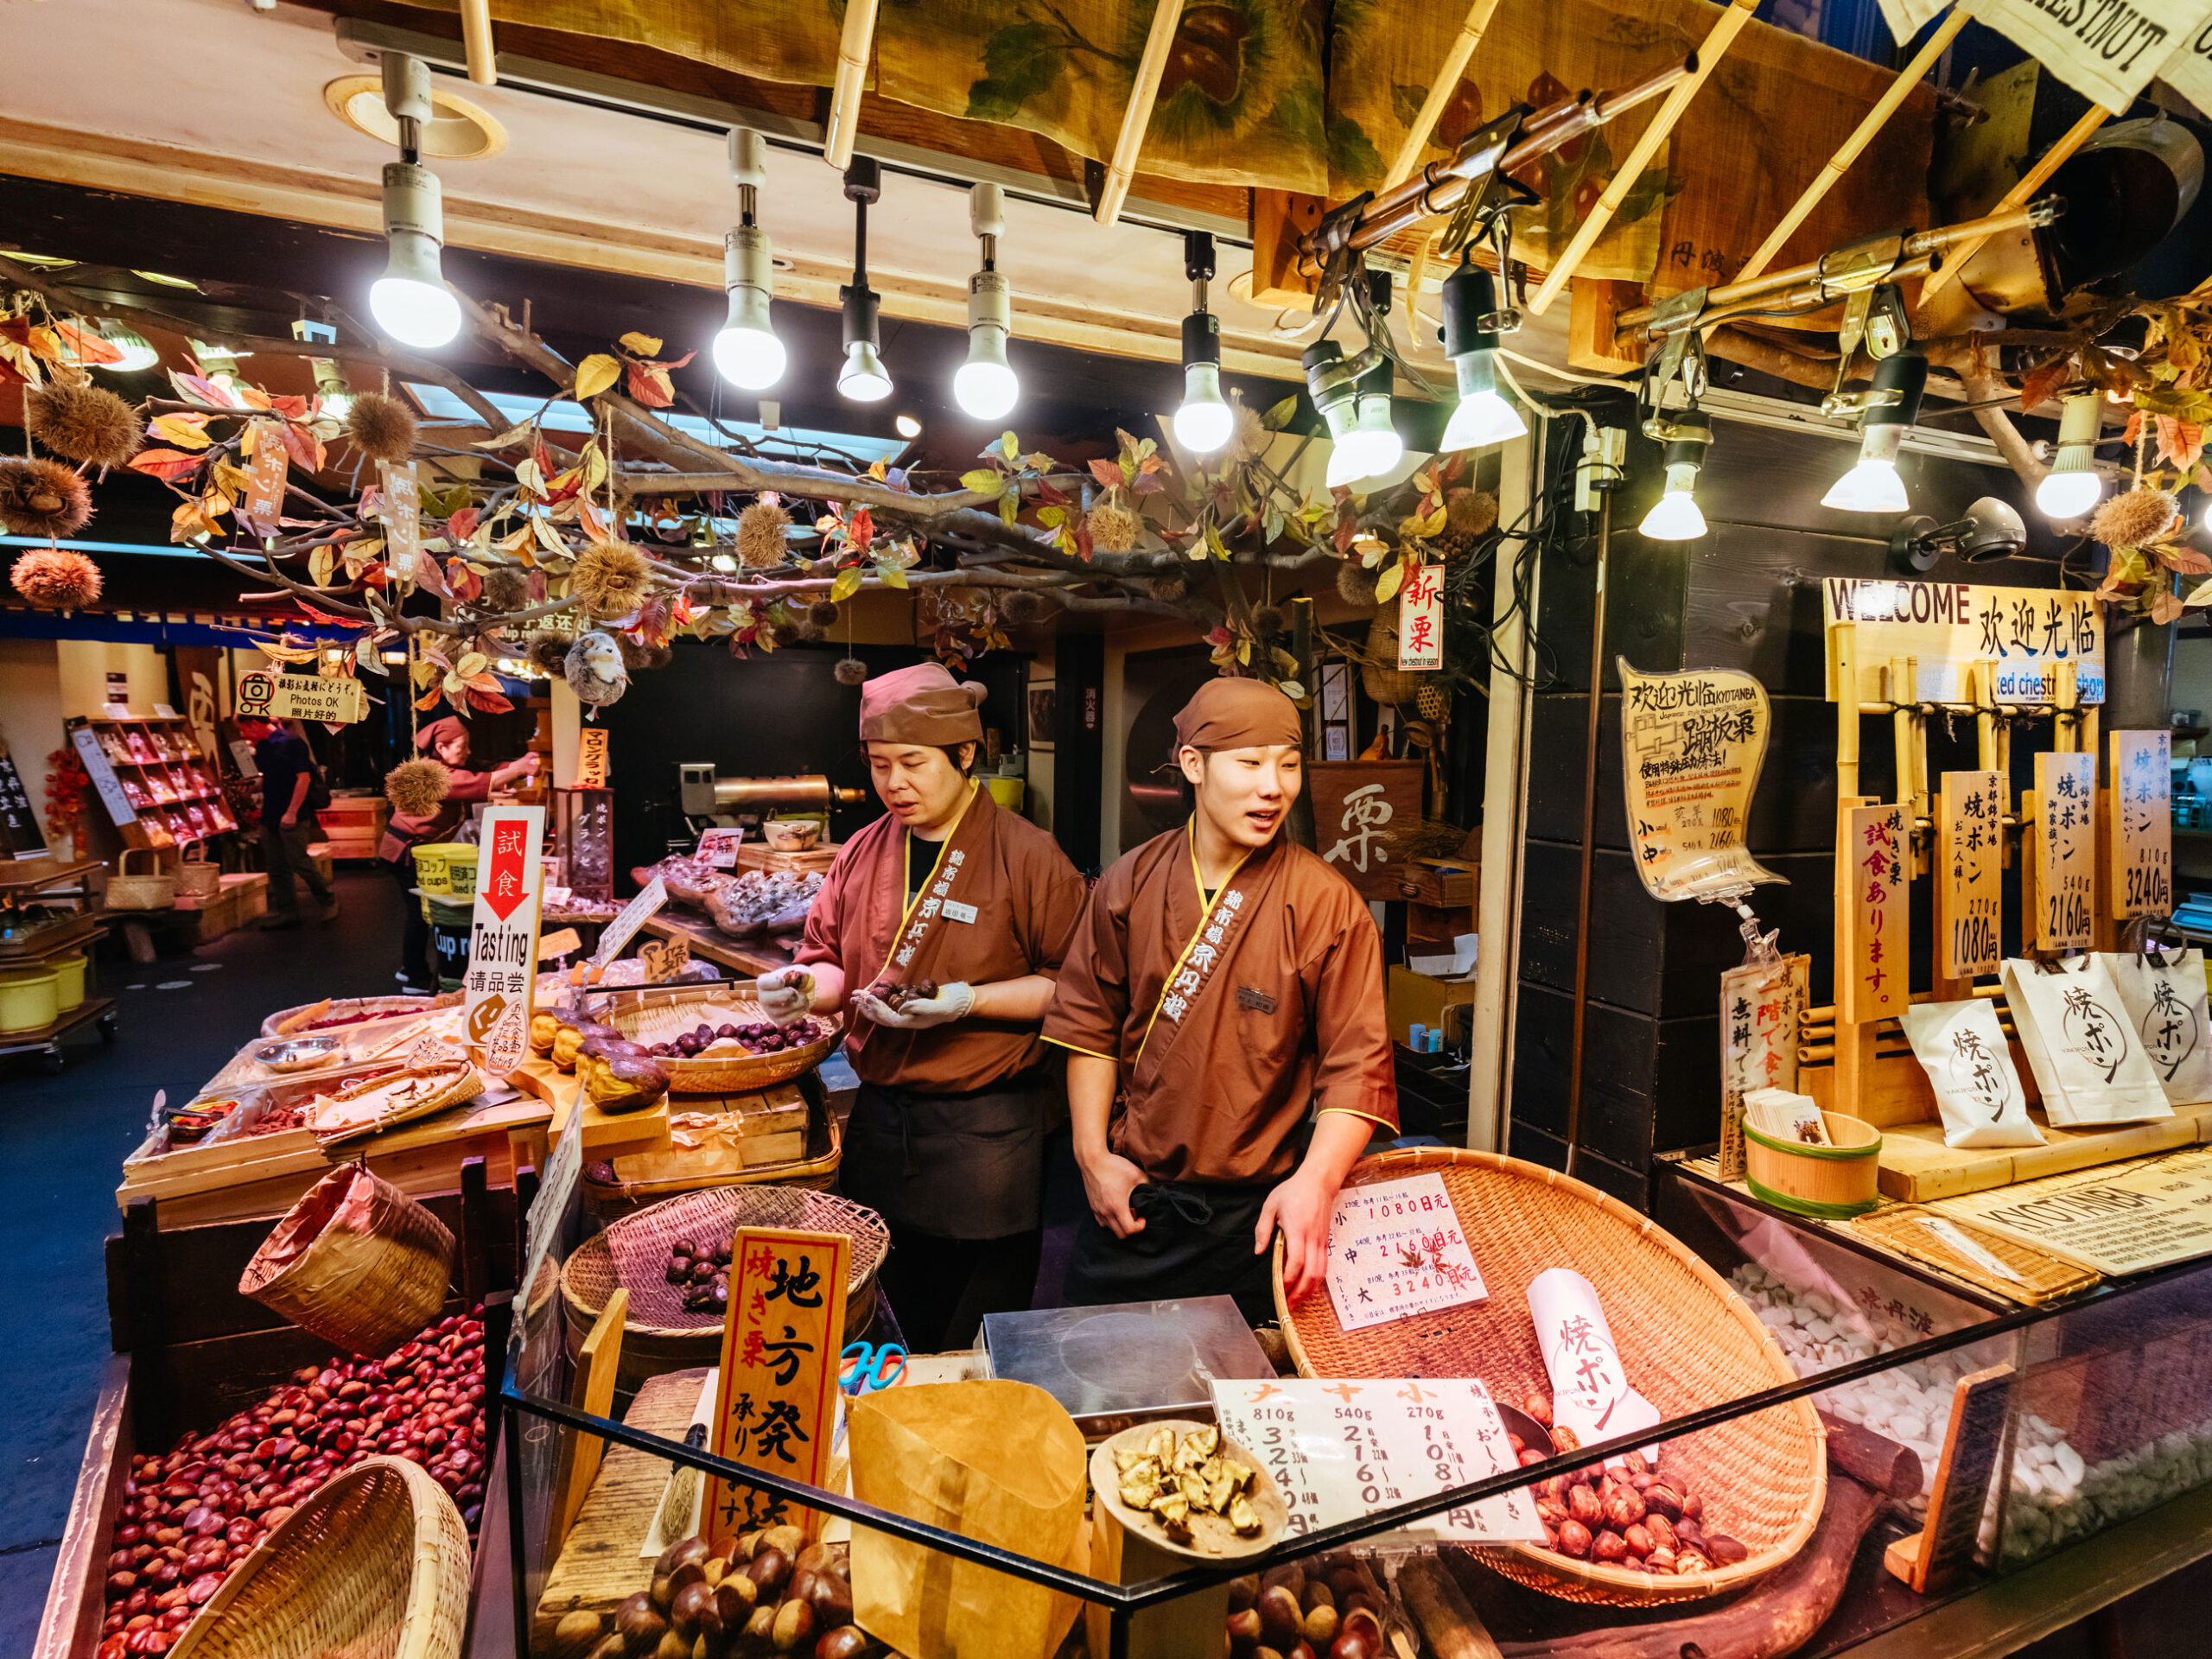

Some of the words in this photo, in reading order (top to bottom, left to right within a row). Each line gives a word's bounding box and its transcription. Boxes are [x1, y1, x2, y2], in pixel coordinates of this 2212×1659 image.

[1406, 575, 1439, 653] 新栗
[1980, 596, 2094, 658] 欢迎光临
[290, 693, 322, 707] Photos
[326, 696, 340, 708] OK
[1630, 679, 1715, 712] 欢迎光临
[1715, 686, 1757, 704] KYOTANBA
[2076, 673, 2104, 699] shop
[291, 708, 337, 721] 照片好的
[1987, 775, 1998, 847] 京都錦市場
[2133, 748, 2152, 833] 焼ポン
[1323, 784, 1395, 874] 栗
[1638, 820, 1655, 836] 小
[1964, 791, 1986, 883] 焼ポン
[2057, 772, 2077, 861] 焼ポン
[579, 813, 592, 867] グラッセ
[1643, 844, 1658, 863] 中
[1887, 809, 1904, 887] 焼き栗
[2140, 849, 2168, 864] 810g
[427, 877, 448, 887] cups
[494, 830, 522, 897] 試食
[2063, 875, 2091, 892] 540g
[1969, 899, 1998, 916] 270g
[2126, 867, 2169, 907] 3240円
[1862, 822, 1891, 1003] 試食あります。
[2049, 893, 2091, 938] 2160円
[435, 926, 456, 962] Cup
[474, 923, 529, 968] Tasting
[1955, 918, 1998, 965] 1080円
[469, 971, 525, 994] 请品尝
[1781, 965, 1793, 1043] 焼ポン
[2063, 986, 2119, 1084] 焼ポン
[2153, 980, 2184, 1083] 焼ポン
[1954, 1028, 2005, 1123] 焼ポン
[1335, 1211, 1347, 1226] 小
[1370, 1193, 1449, 1219] 1080日元
[1977, 1187, 2165, 1232] KYOTANBA
[1344, 1248, 1357, 1265] 中
[1380, 1230, 1463, 1257] 2160日元
[1357, 1287, 1374, 1305] 大
[1393, 1266, 1478, 1296] 3240日元
[741, 1246, 779, 1369] 焼き栗
[1396, 1382, 1439, 1404] 小
[1559, 1313, 1616, 1432] 焼ポン
[1254, 1408, 1295, 1421] 810g
[1334, 1408, 1373, 1421] 540g
[1407, 1407, 1444, 1420] 270g
[1344, 1426, 1389, 1515] 2160
[1477, 1428, 1521, 1521] おしき
